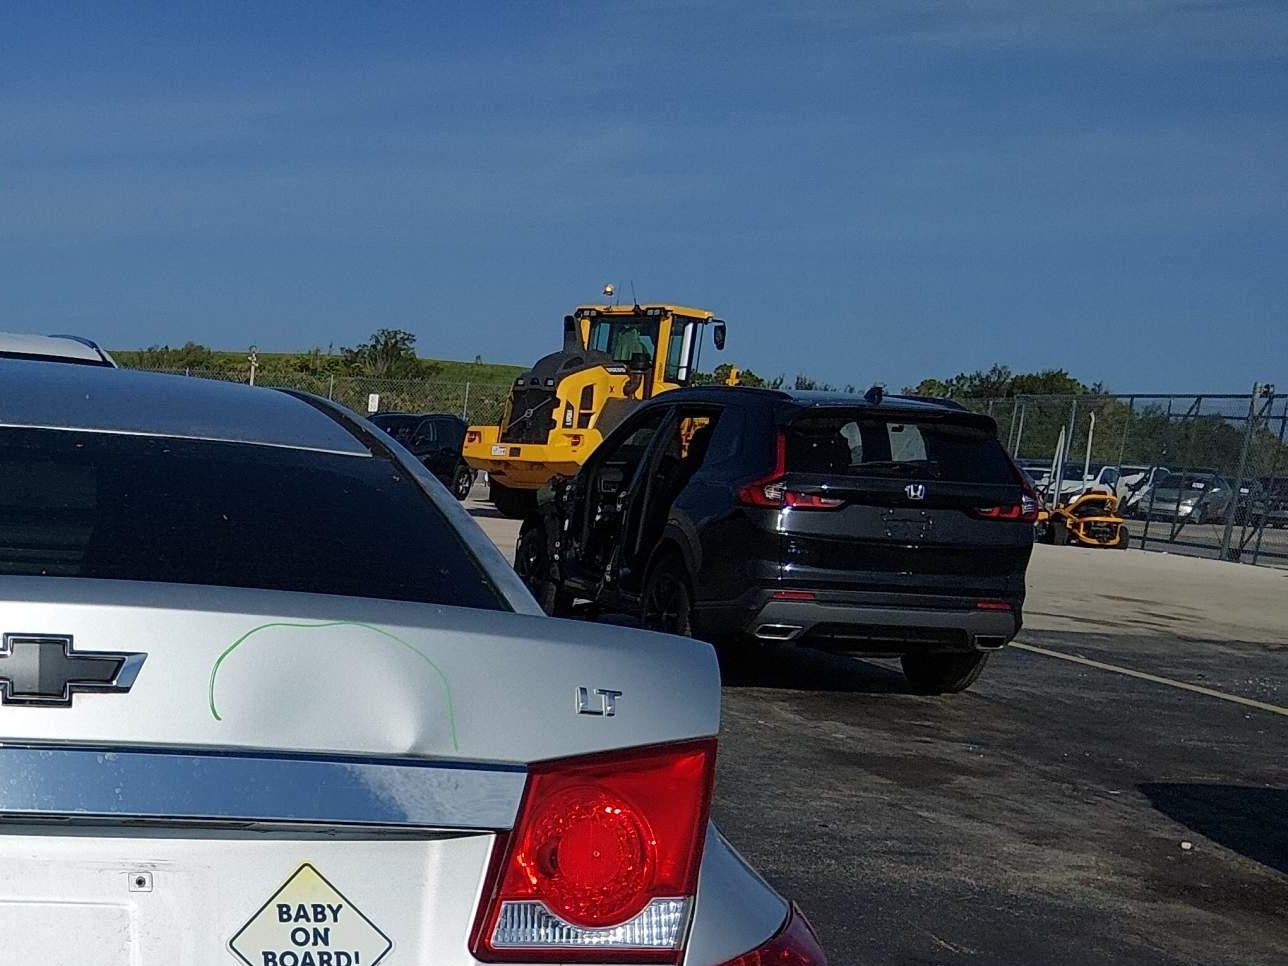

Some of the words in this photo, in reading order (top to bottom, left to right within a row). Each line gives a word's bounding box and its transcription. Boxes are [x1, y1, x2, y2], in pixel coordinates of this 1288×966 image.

[575, 686, 623, 718] LT
[276, 903, 343, 923] BABY
[290, 927, 330, 947] ON
